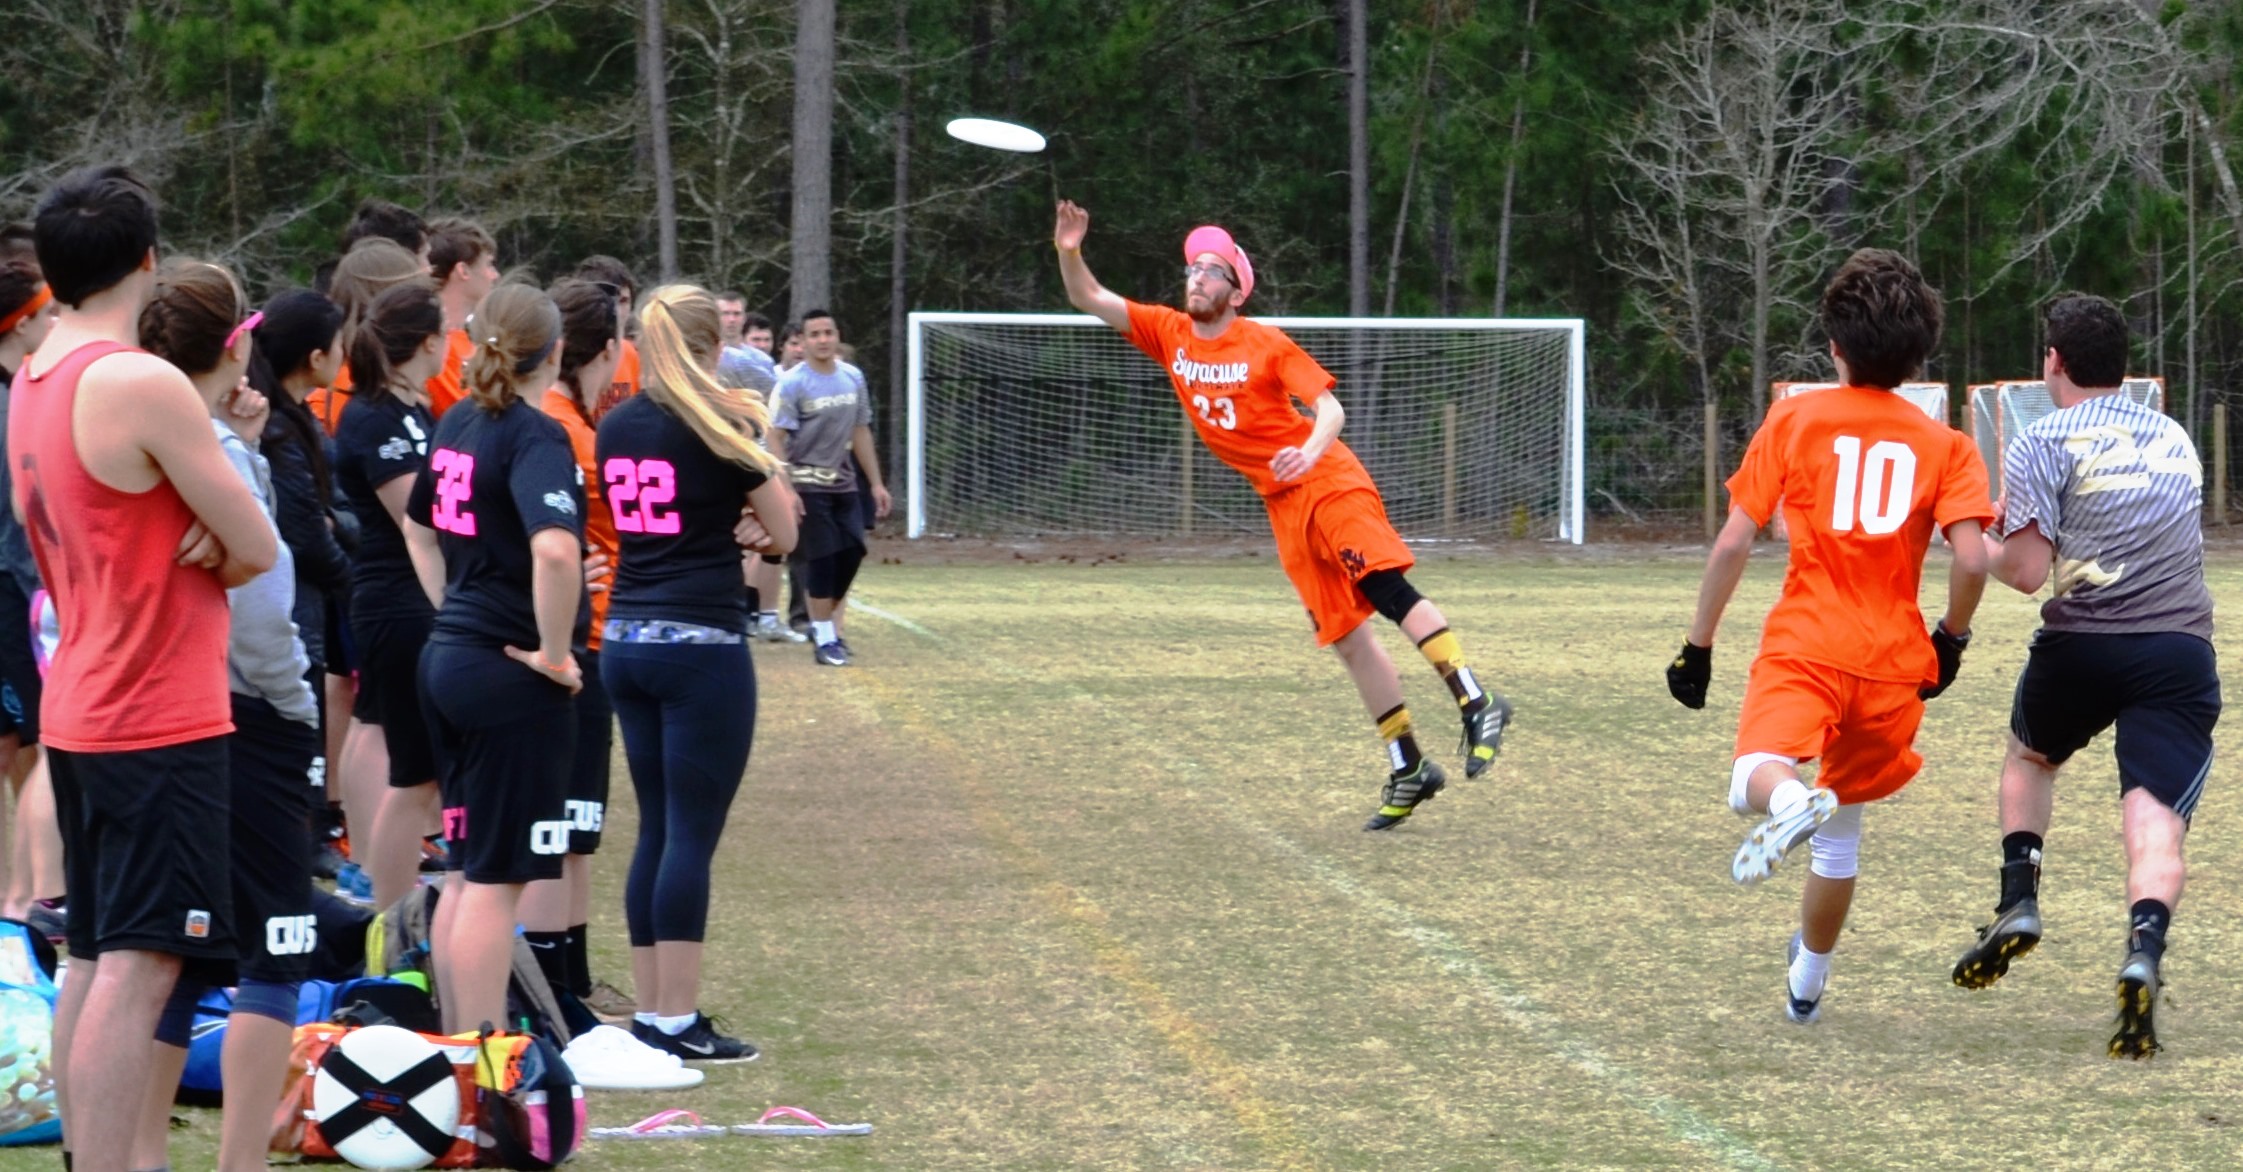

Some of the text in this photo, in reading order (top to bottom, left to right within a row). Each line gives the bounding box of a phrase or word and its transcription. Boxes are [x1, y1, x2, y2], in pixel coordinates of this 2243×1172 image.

[1172, 348, 1249, 387] Syracuse
[1193, 395, 1237, 430] 23
[431, 449, 477, 536] 32
[604, 458, 681, 534] 22
[1832, 435, 1917, 535] 10
[266, 915, 317, 955] CUS
